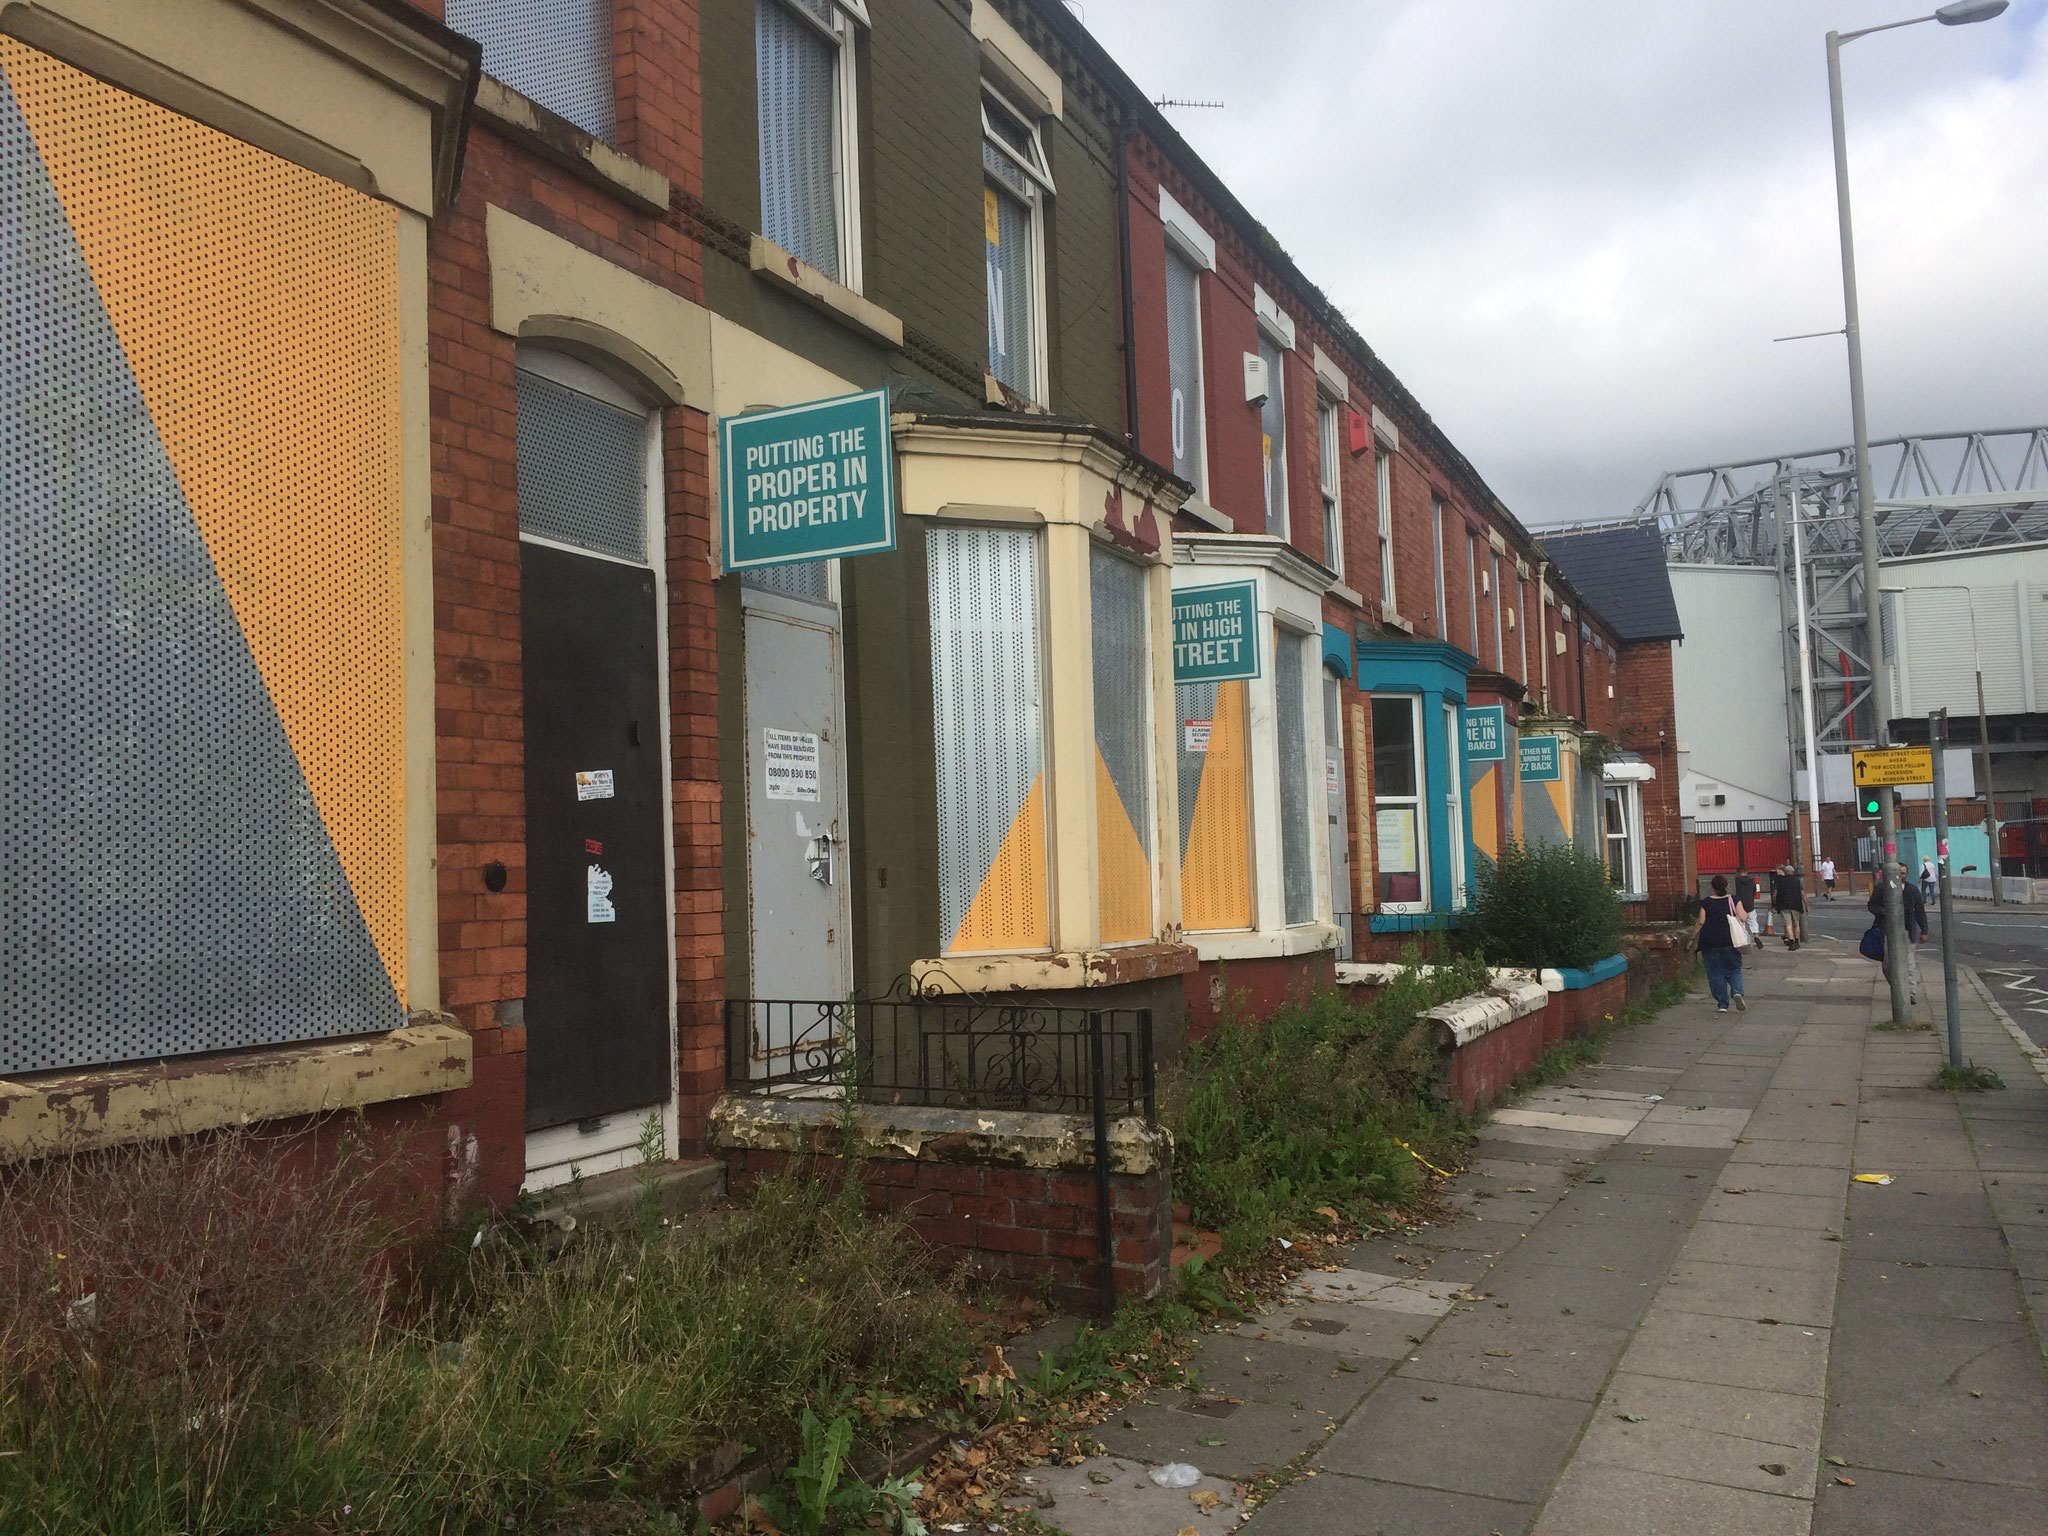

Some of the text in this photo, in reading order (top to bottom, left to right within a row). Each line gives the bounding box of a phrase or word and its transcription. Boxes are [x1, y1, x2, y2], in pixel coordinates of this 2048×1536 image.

[746, 426, 866, 470] PUTTING THE
[747, 455, 868, 503] PROPER IN
[748, 489, 868, 535] PROPERTY
[1216, 599, 1242, 616] THE
[1181, 621, 1198, 641] IN
[1202, 616, 1242, 638] HIGH
[1174, 638, 1243, 668] TREET
[1479, 717, 1495, 726] THE
[1483, 727, 1496, 739] IN
[1468, 741, 1496, 750] BAKED
[1520, 747, 1541, 755] ETHER
[793, 754, 815, 762] PROPERTY
[1531, 762, 1552, 771] BACK
[791, 769, 803, 778] 830
[805, 770, 816, 779] 850
